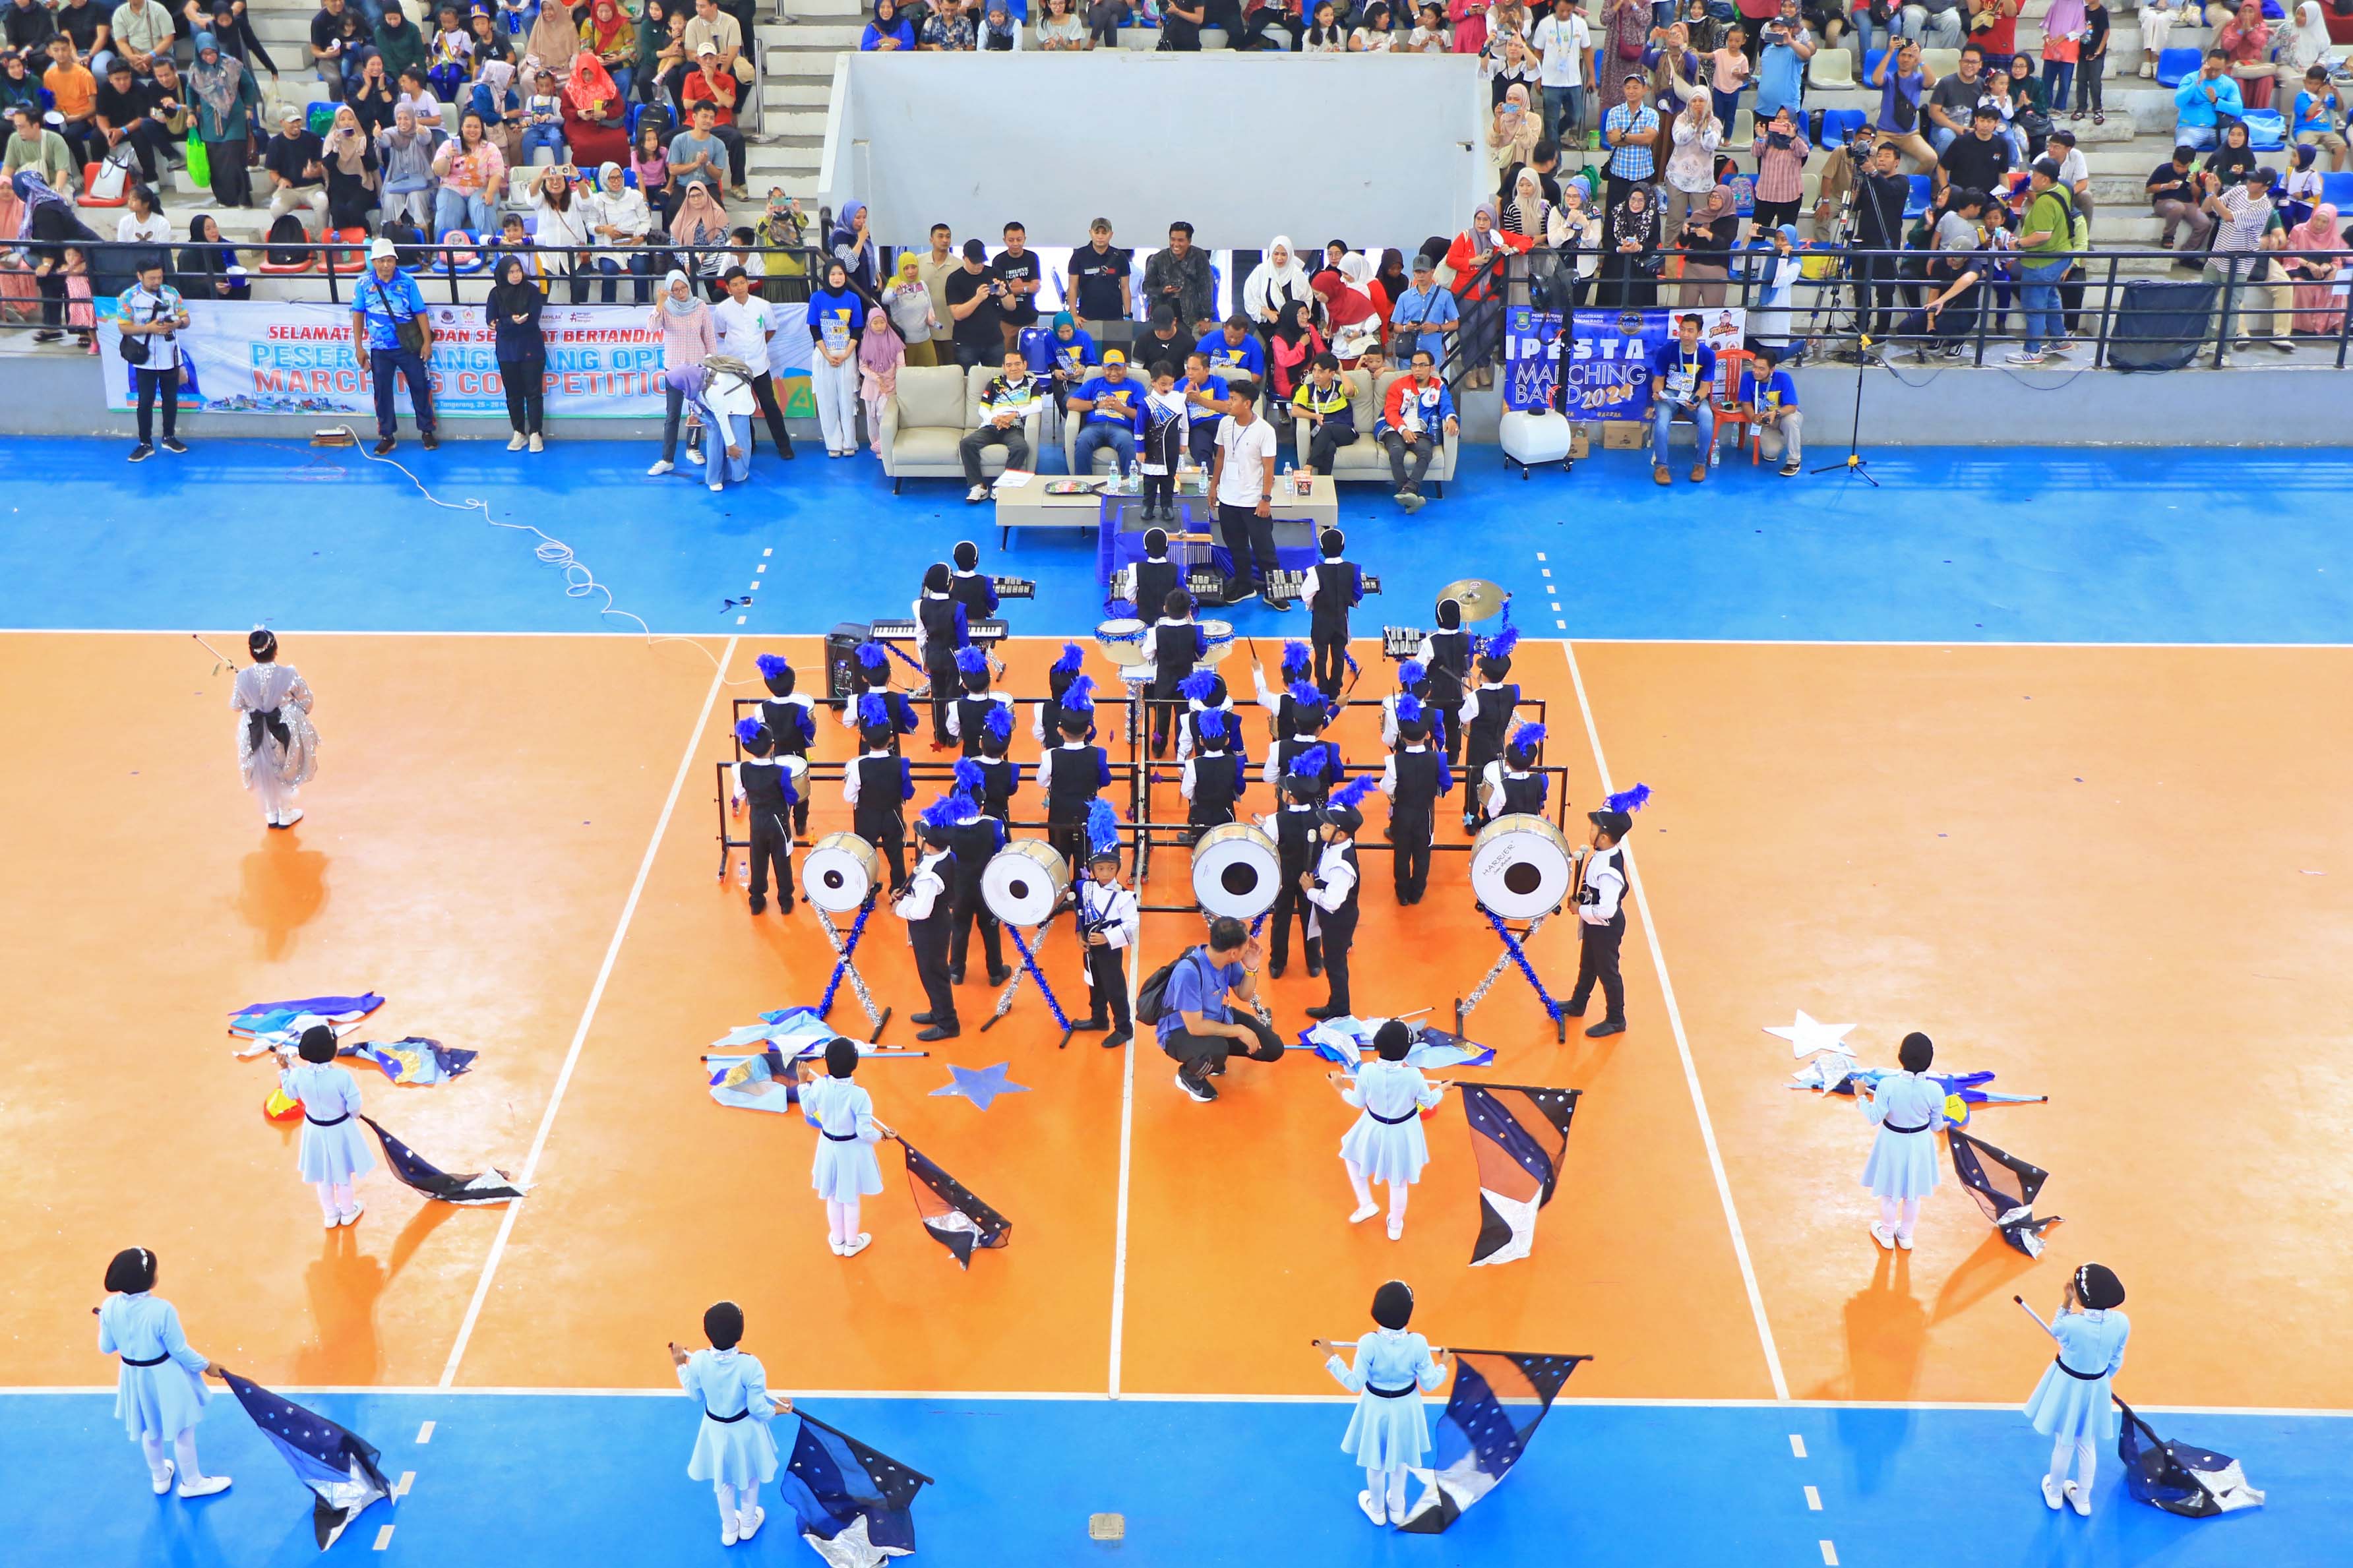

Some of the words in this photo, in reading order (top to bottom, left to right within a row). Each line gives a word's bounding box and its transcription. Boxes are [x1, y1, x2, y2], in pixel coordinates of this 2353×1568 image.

[268, 326, 351, 340] SELAMAT
[434, 329, 470, 342] DAN
[475, 330, 559, 342] SEAT
[563, 329, 664, 343] BERTANDIN
[252, 344, 356, 367] PESER
[612, 349, 665, 369] OPE
[253, 370, 444, 394] MARCHNG
[458, 372, 667, 394] COPETITIO
[1581, 383, 1634, 410] 2024
[1482, 844, 1515, 875] HARRIER
